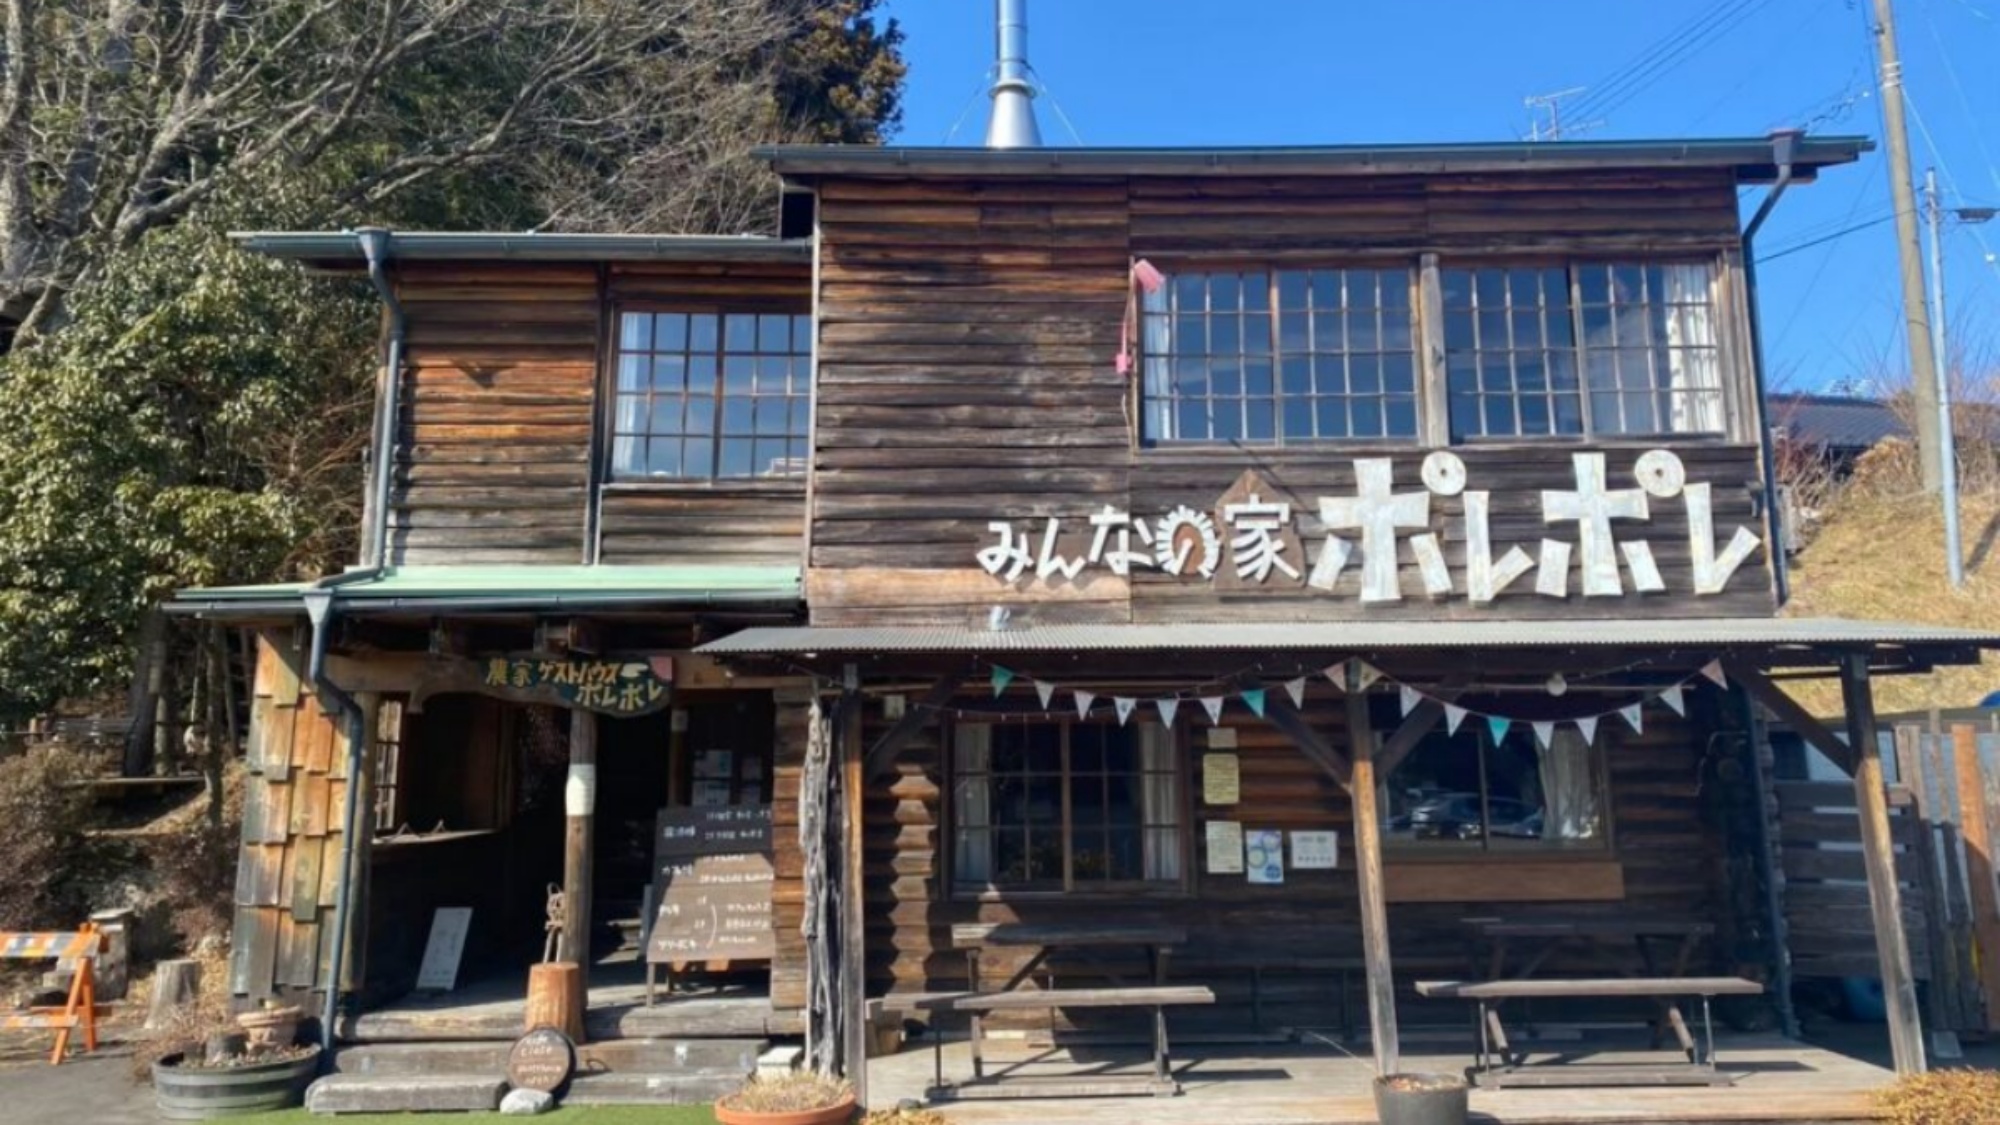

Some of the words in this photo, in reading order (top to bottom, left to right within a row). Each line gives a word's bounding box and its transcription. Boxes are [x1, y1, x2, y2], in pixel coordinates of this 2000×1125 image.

[975, 493, 1303, 582] みんなの家
[1307, 449, 1762, 602] ポレポレ
[485, 657, 533, 687] 農家
[538, 659, 622, 685] ゲストハウス
